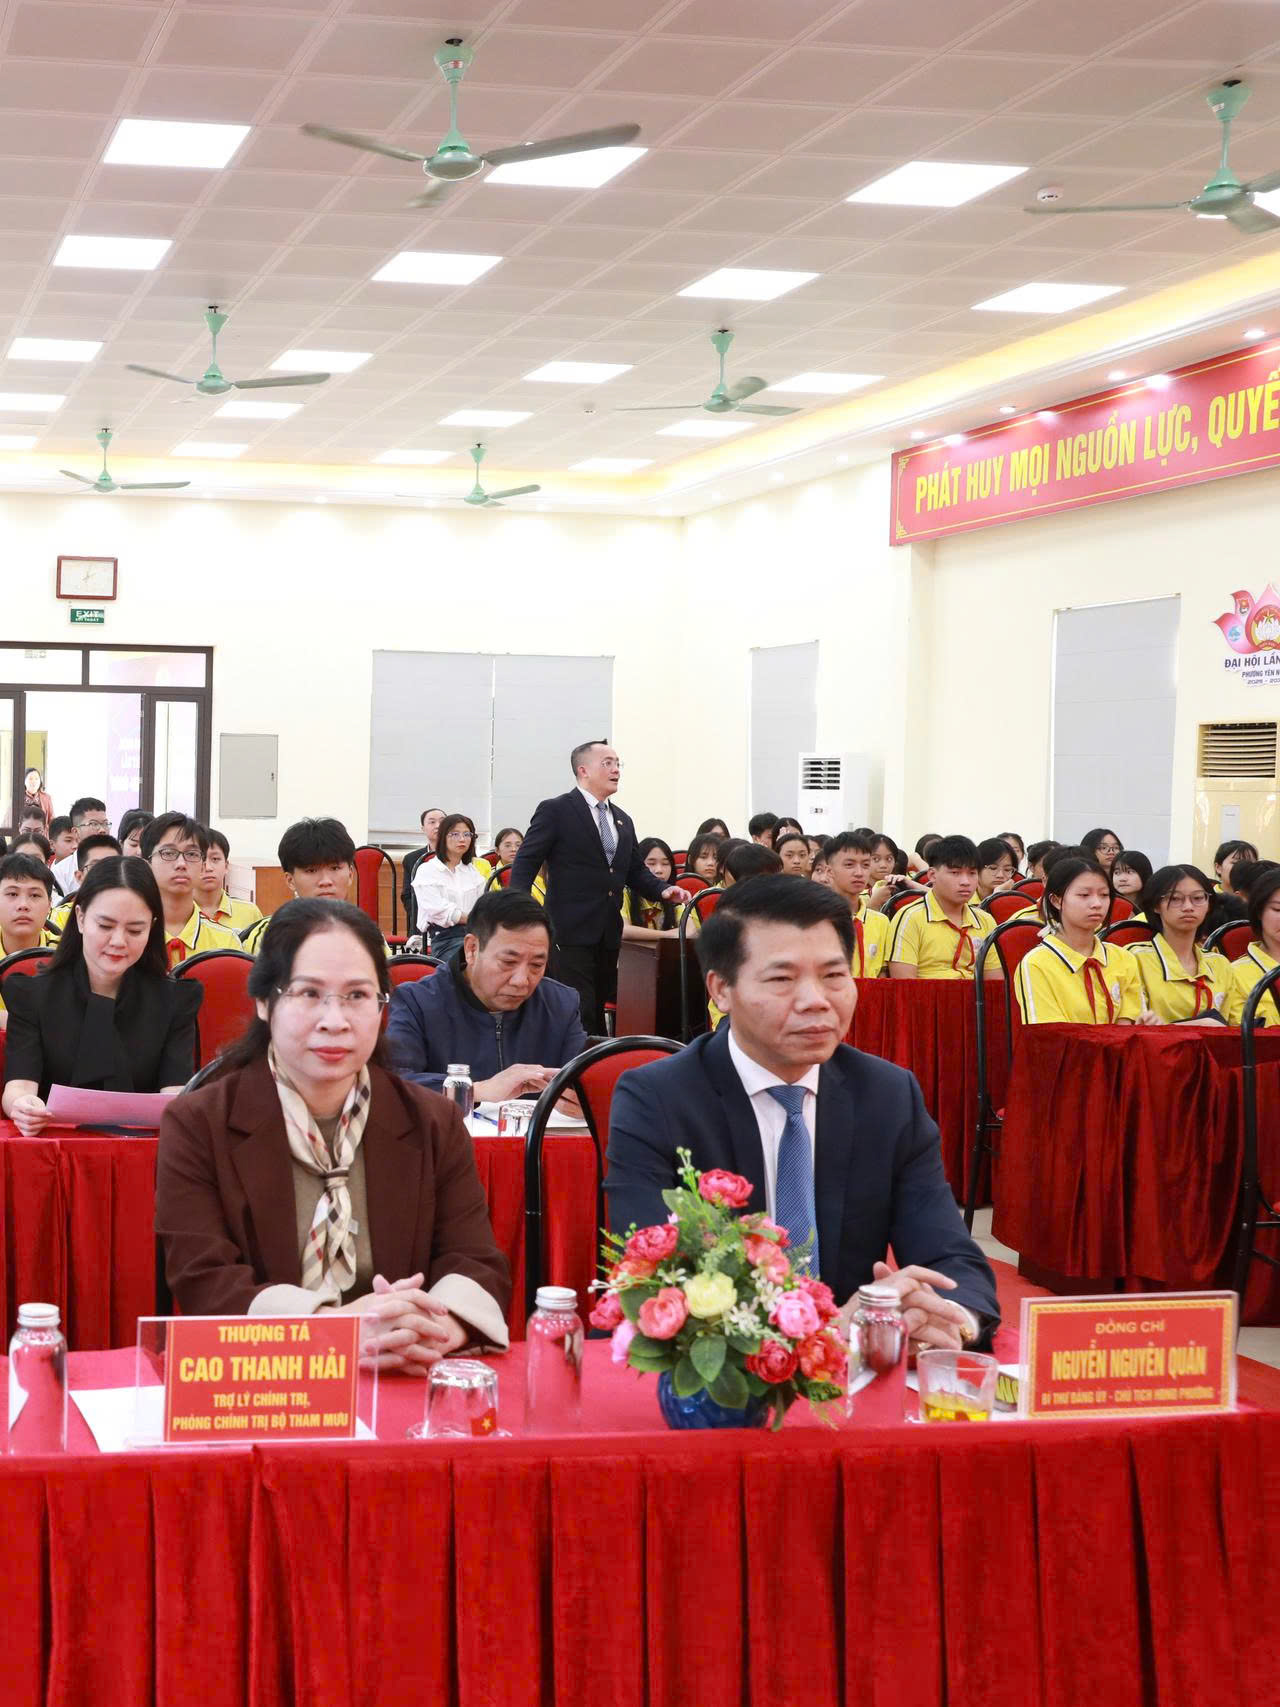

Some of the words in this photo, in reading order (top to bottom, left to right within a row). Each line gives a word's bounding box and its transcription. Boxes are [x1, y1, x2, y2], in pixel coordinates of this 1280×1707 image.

[915, 461, 961, 513] PHÁT
[966, 455, 1004, 503] HUY
[1009, 443, 1050, 496] MỌI
[1056, 410, 1136, 481] NGUỒN
[1144, 403, 1199, 467] LỰC,
[1208, 368, 1280, 449] QUYẾ
[1224, 658, 1241, 670] ĐẠI
[1244, 654, 1261, 668] HỘI
[218, 1323, 285, 1347] THƯỢNG
[290, 1321, 310, 1342] TÁ
[179, 1356, 224, 1382] CAO
[230, 1355, 303, 1381] THANH
[309, 1347, 347, 1379] HẢI
[1051, 1338, 1107, 1381] NGUYỄN
[213, 1393, 235, 1410] TRỢ
[237, 1391, 251, 1407] LÝ
[253, 1390, 287, 1406] CHÍNH
[173, 1412, 211, 1431] PHÒNG
[214, 1412, 249, 1429] CHÍNH
[271, 1411, 286, 1430] BỘ
[289, 1413, 320, 1427] THAM
